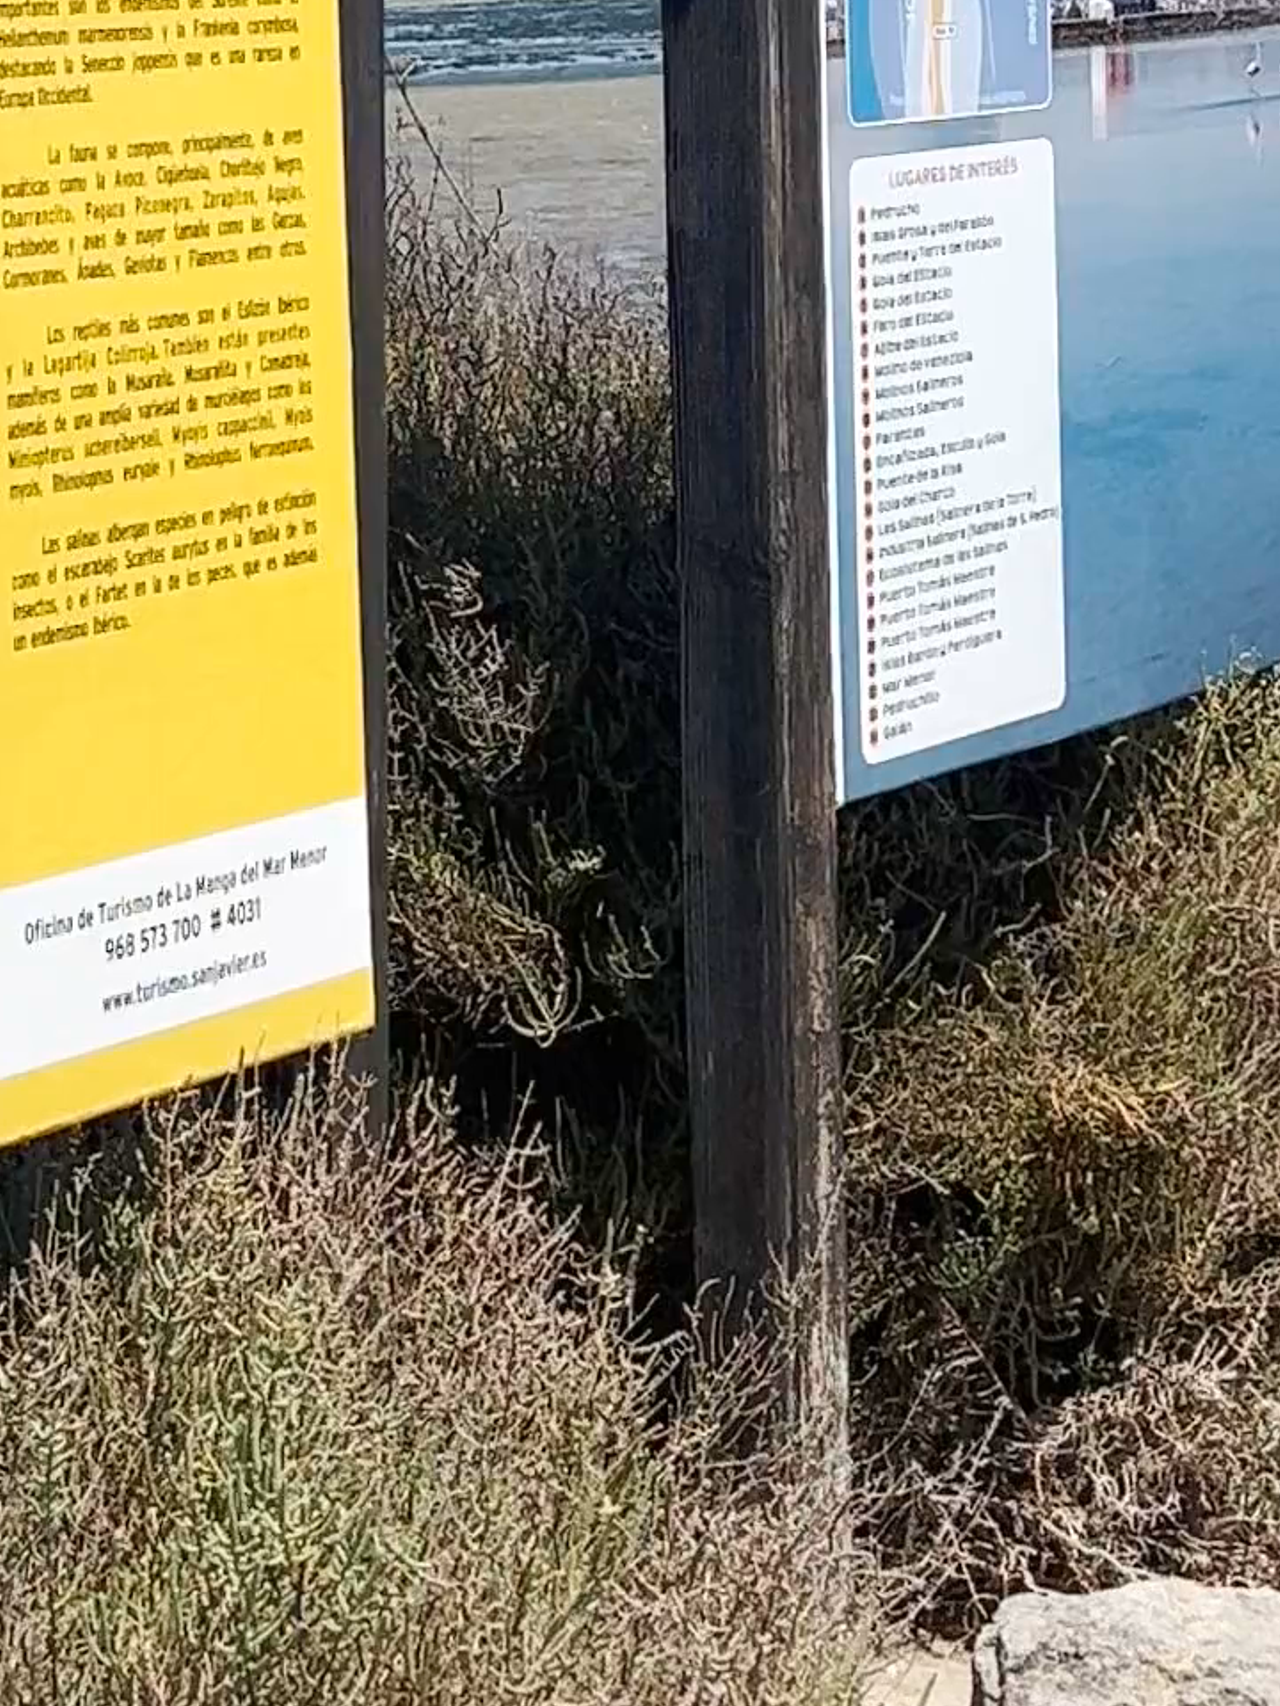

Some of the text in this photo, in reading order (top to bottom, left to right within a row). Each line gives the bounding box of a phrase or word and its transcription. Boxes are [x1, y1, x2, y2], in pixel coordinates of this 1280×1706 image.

[25, 847, 327, 944] Oficina de Turismo de La Manga del Mar Menor
[106, 898, 260, 960] 968 573 700 # 4031
[103, 949, 267, 1012] www.turismo.sanjavier.es
